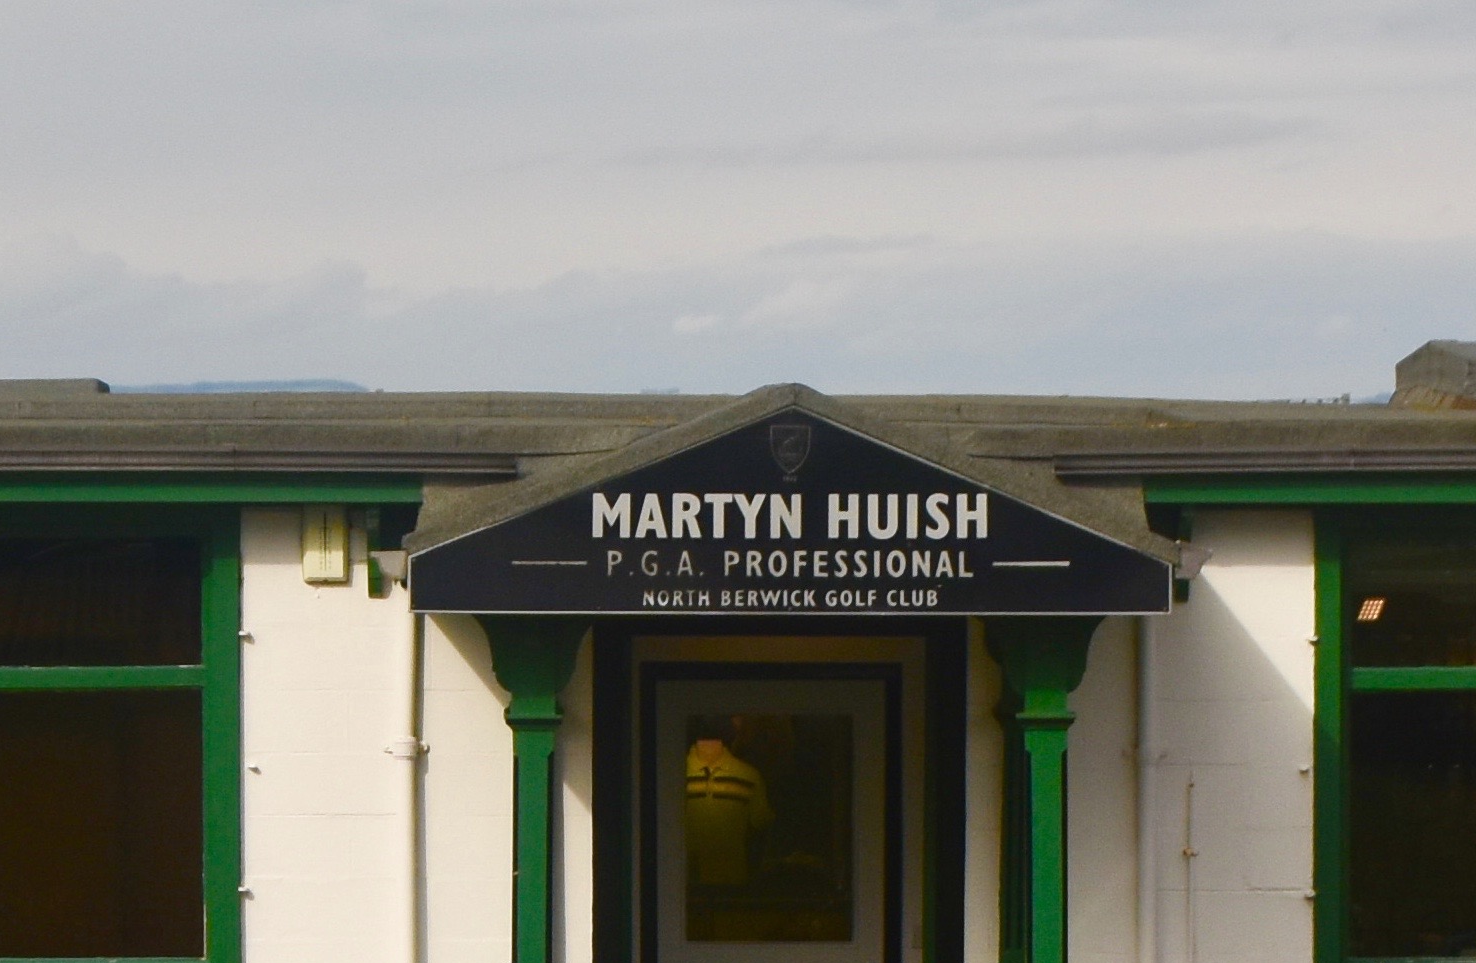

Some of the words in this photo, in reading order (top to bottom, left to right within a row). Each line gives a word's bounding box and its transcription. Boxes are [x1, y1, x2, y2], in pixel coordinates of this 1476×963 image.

[592, 491, 802, 540] MARTYN
[827, 491, 989, 540] HUISH
[606, 548, 705, 578] P.G.A.
[722, 548, 975, 578] PROFESSIONAL
[641, 589, 712, 608] NORTH
[720, 589, 818, 608] BERWICK
[824, 589, 878, 608] GOLF
[886, 589, 939, 608] CLUB
